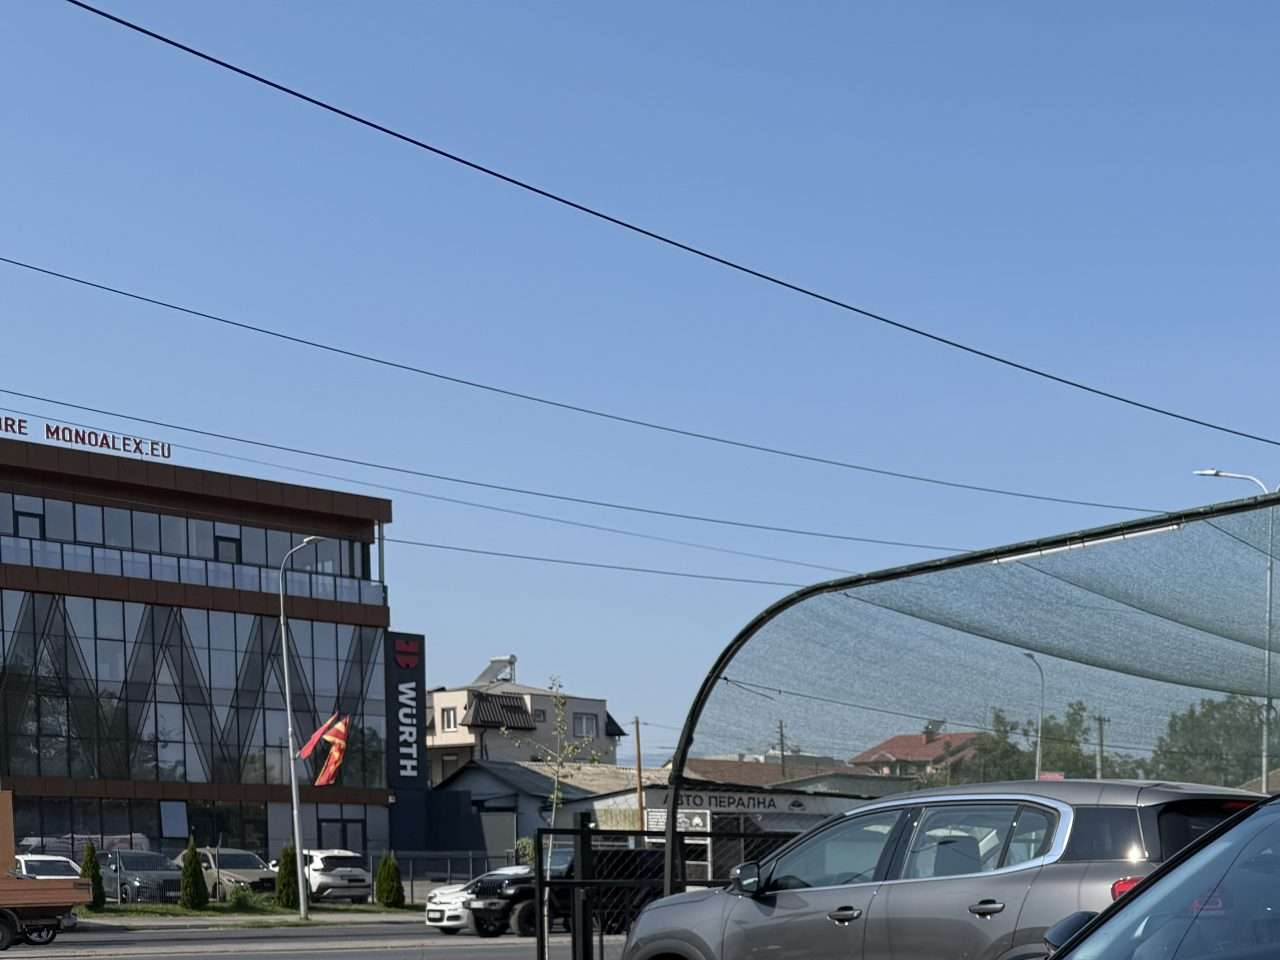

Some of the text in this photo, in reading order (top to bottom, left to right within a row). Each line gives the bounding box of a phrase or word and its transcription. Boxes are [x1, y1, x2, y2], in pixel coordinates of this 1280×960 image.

[45, 423, 171, 459] MONOALEX.EU
[397, 681, 418, 777] WÜRTH
[708, 795, 777, 810] ПЕРАЛНА
